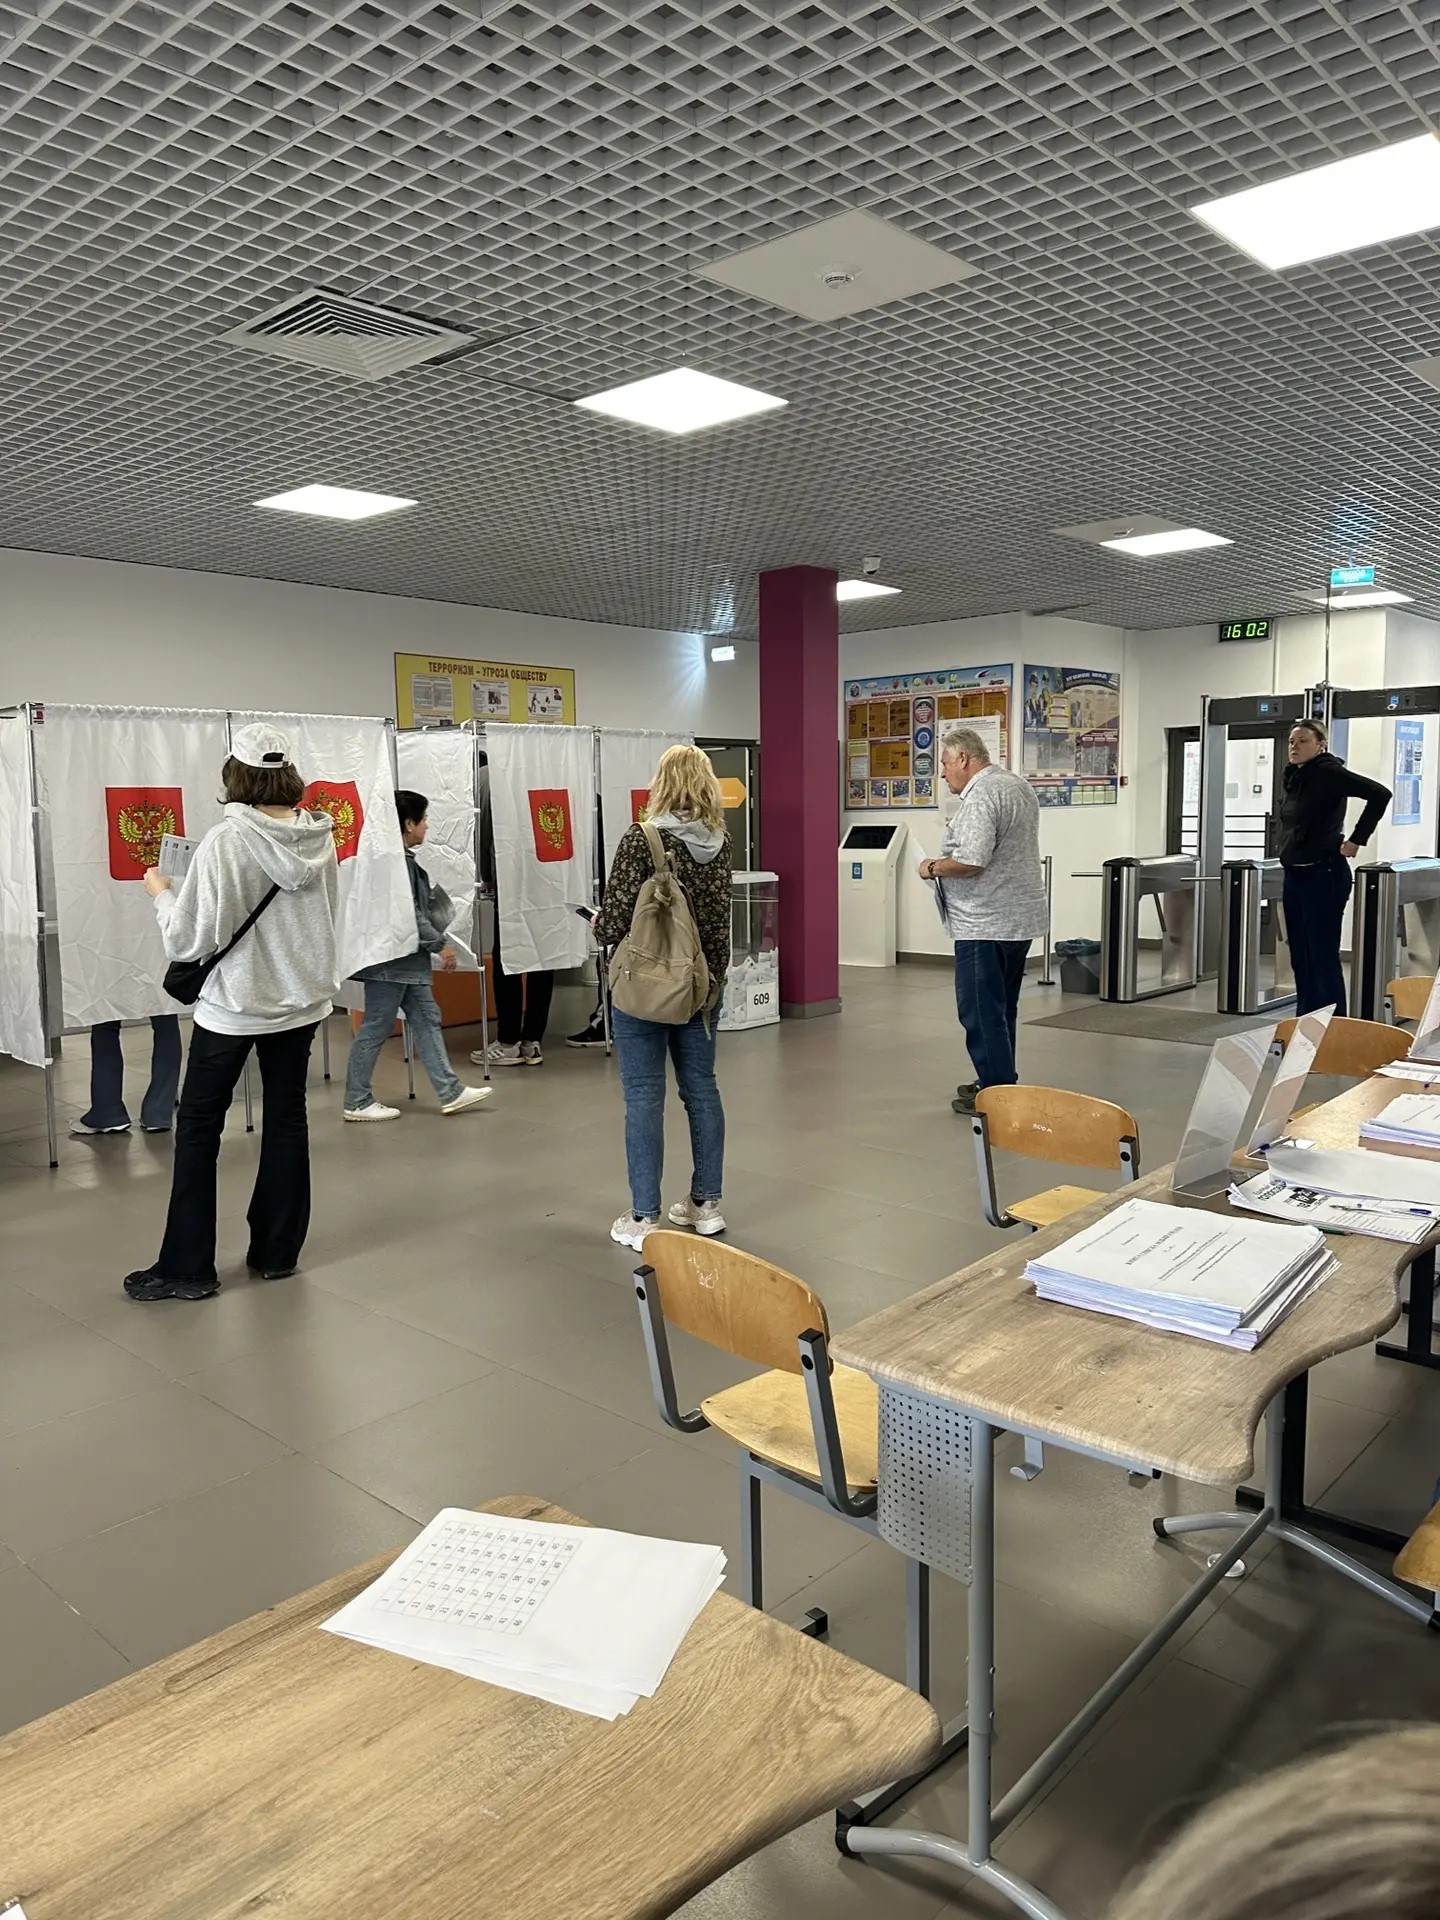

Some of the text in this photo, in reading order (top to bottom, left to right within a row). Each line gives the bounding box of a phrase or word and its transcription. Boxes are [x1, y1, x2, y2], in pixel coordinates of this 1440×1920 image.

[428, 661, 474, 676] ТЕРРОРИЗМ
[482, 666, 509, 678] УГРОЗА
[511, 669, 548, 682] ОБЩЕСТВУ
[753, 992, 770, 1006] 609
[455, 1586, 466, 1594] 22
[470, 1567, 480, 1575] 23
[456, 1565, 467, 1573] 18
[428, 1581, 438, 1589] 12
[484, 1591, 494, 1599] 32
[497, 1572, 508, 1580] 33
[453, 1609, 464, 1617] 26
[469, 1588, 479, 1597] 27
[482, 1614, 493, 1622] 36
[498, 1593, 507, 1601] 37
[513, 1596, 523, 1604] 42
[513, 1619, 523, 1627] 46
[528, 1598, 536, 1606] 47
